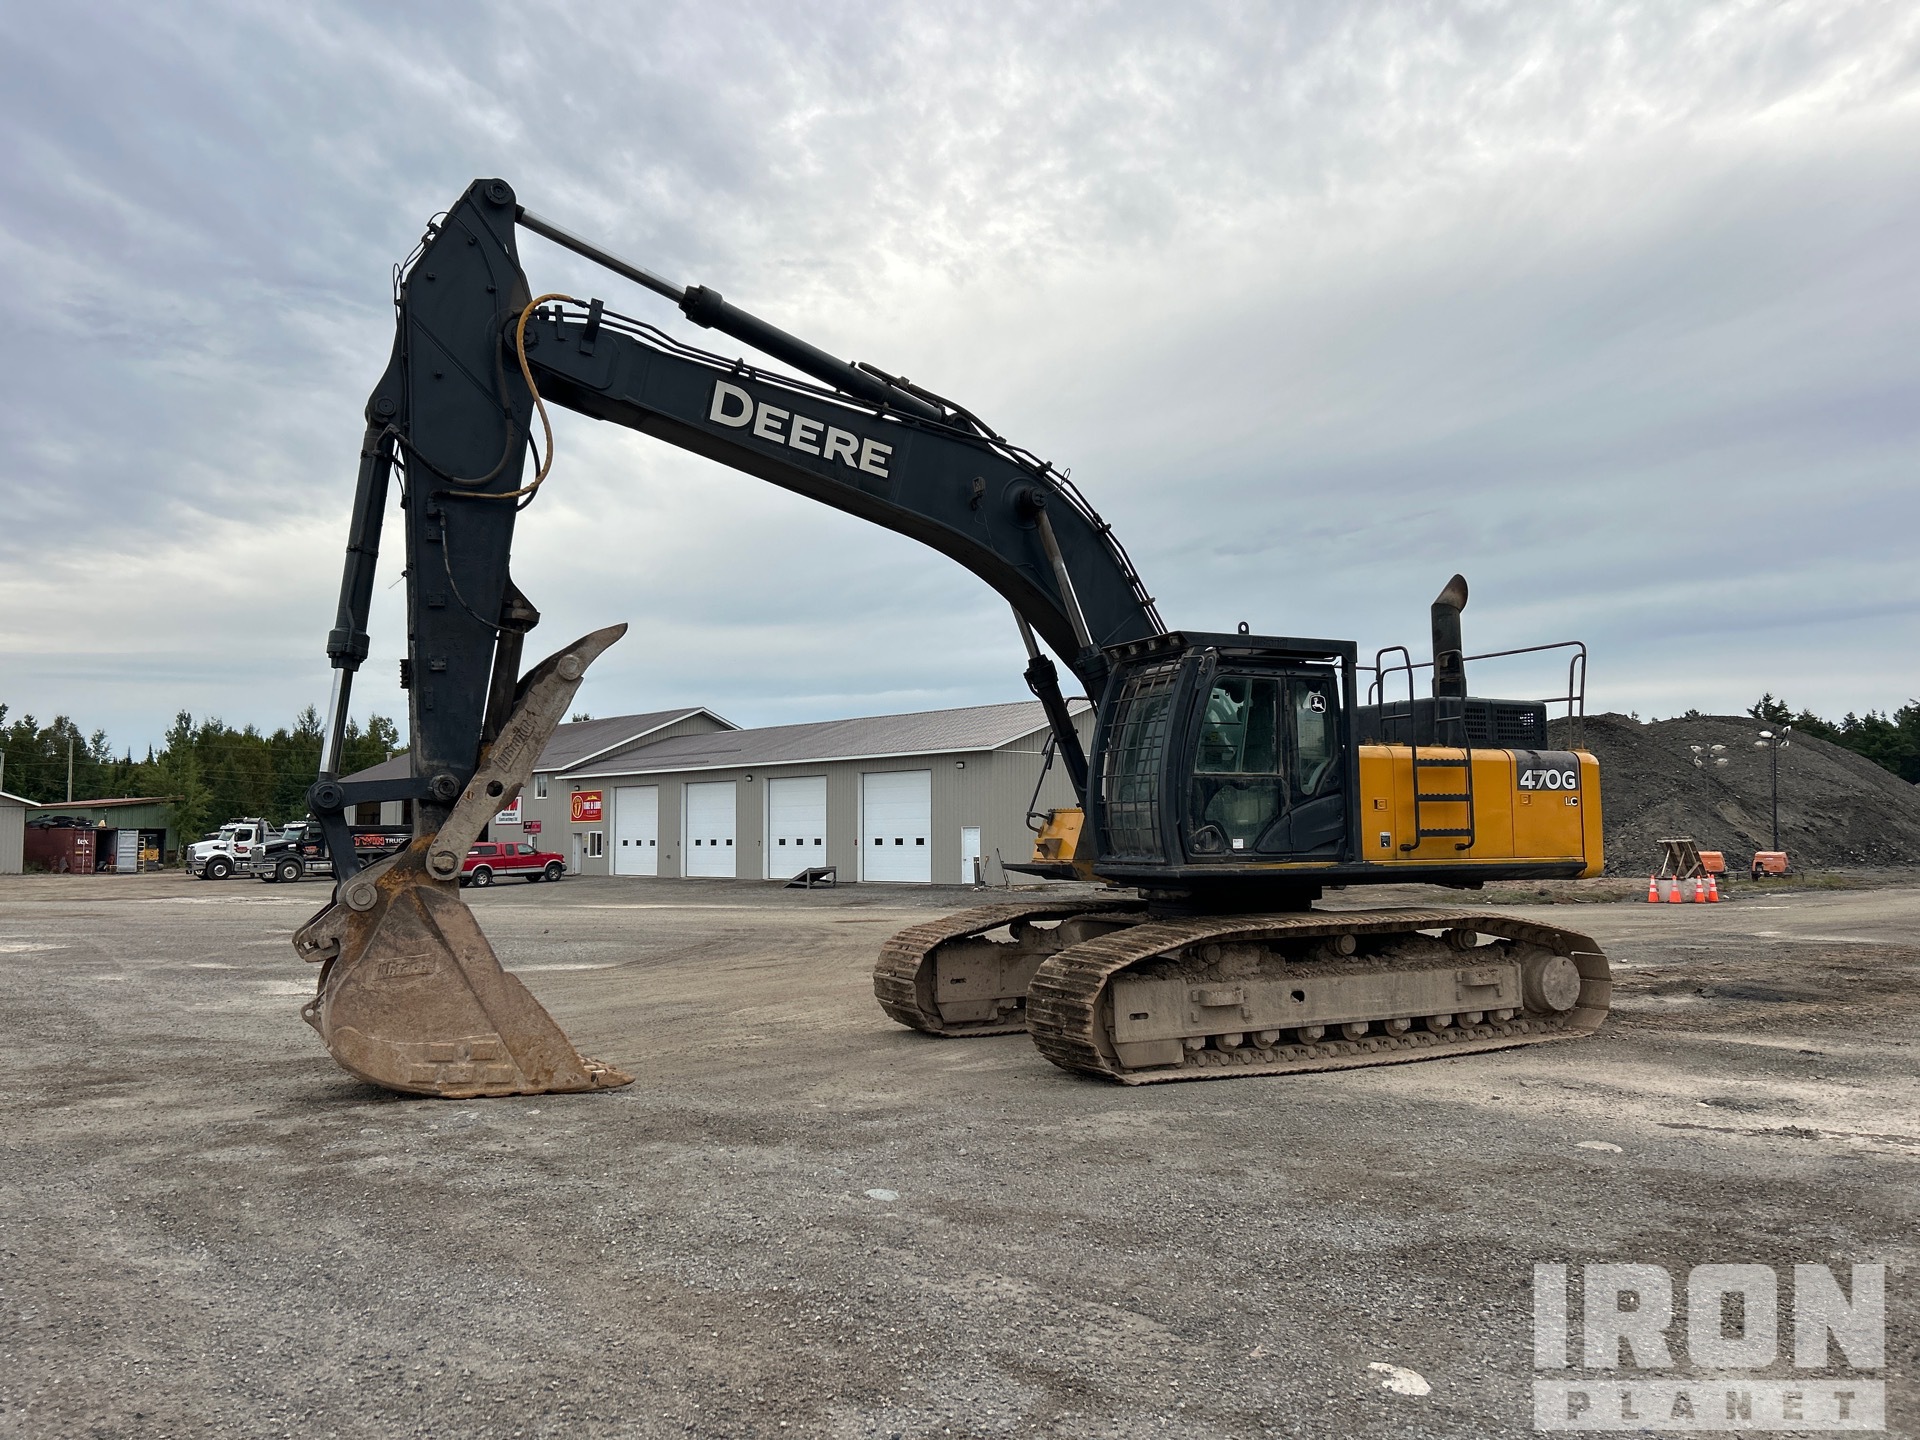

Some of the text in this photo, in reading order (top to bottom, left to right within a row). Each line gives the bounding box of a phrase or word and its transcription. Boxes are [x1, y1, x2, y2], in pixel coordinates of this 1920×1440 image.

[709, 379, 893, 479] DEERE
[1519, 769, 1576, 790] 470G
[1565, 797, 1578, 806] LC
[354, 836, 385, 846] TWIN
